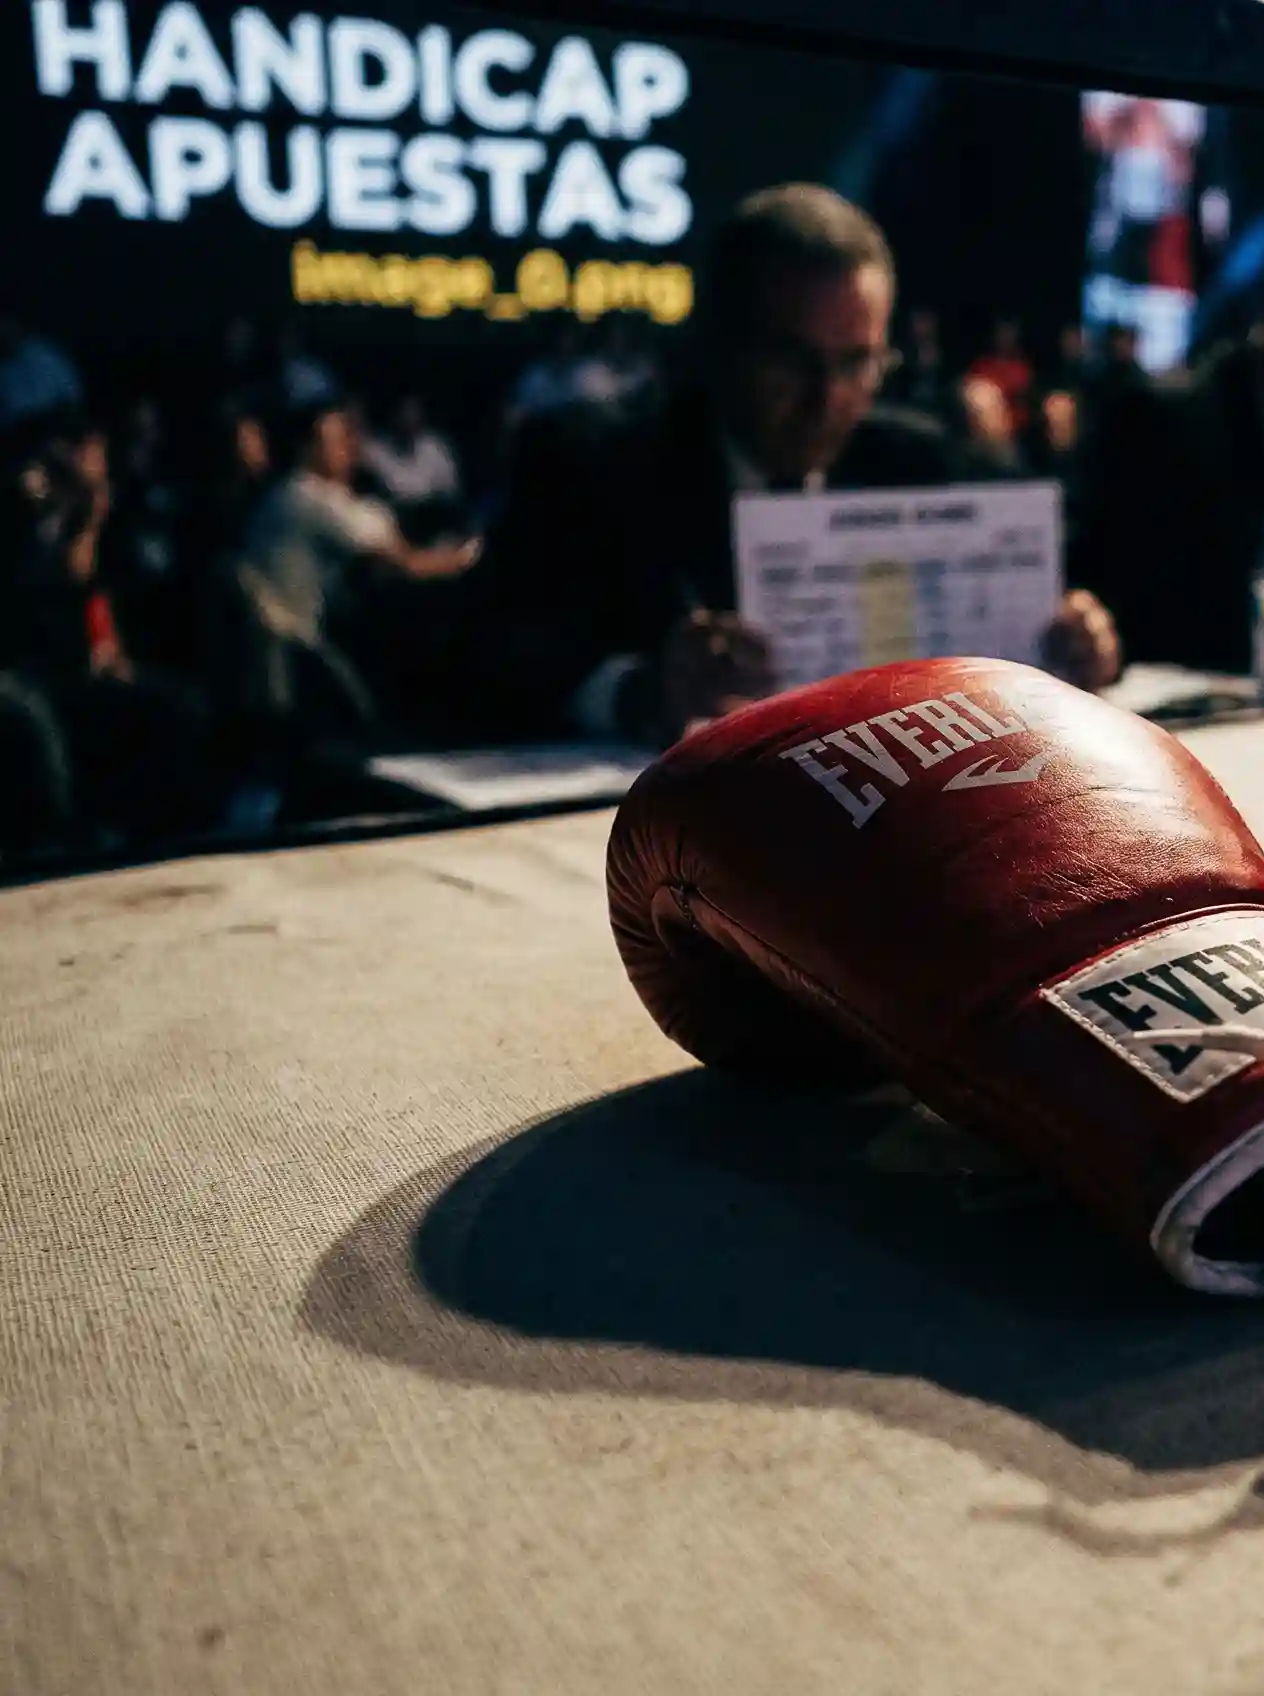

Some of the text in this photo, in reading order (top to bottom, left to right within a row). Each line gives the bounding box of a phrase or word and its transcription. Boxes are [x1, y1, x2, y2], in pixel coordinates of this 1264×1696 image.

[31, 0, 690, 139] HANDICAP
[44, 110, 693, 245] APUESTAS
[778, 691, 1027, 830] EVERL
